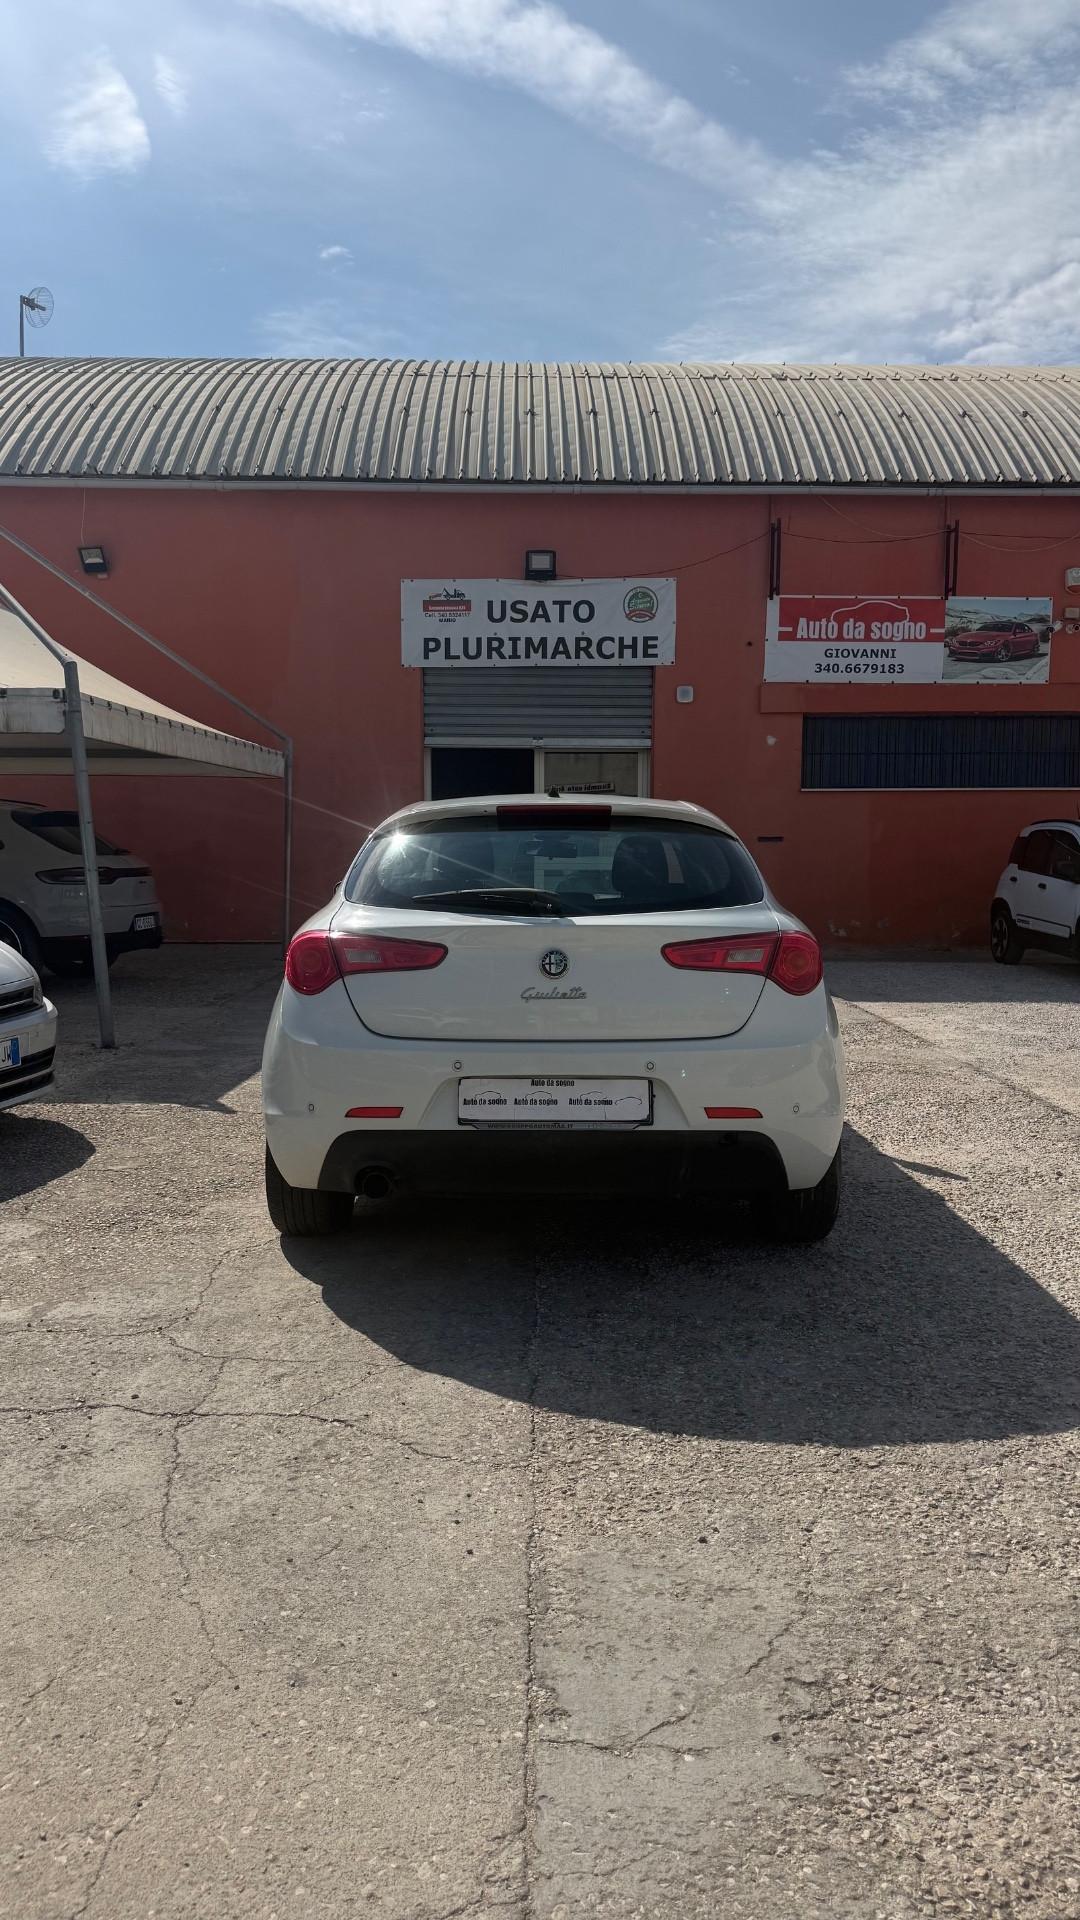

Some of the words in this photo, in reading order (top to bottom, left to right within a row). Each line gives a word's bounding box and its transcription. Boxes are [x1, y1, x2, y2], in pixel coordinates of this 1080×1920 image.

[487, 599, 596, 624] USATO
[796, 617, 839, 640] Auto
[842, 617, 866, 640] da
[870, 620, 927, 642] sogno
[423, 636, 659, 661] PLURIMARCHE
[824, 648, 897, 659] GIOVANNI
[814, 663, 905, 674] 340.6679183
[531, 1079, 546, 1087] Auto
[547, 1079, 555, 1087] da
[556, 1079, 575, 1088] sogno
[463, 1098, 478, 1106] Auto
[479, 1098, 487, 1106] da
[488, 1098, 507, 1106] sogno
[514, 1098, 528, 1106] Auto
[529, 1098, 537, 1106] da
[538, 1098, 558, 1107] sogno
[568, 1098, 583, 1106] Auto
[584, 1098, 593, 1106] da
